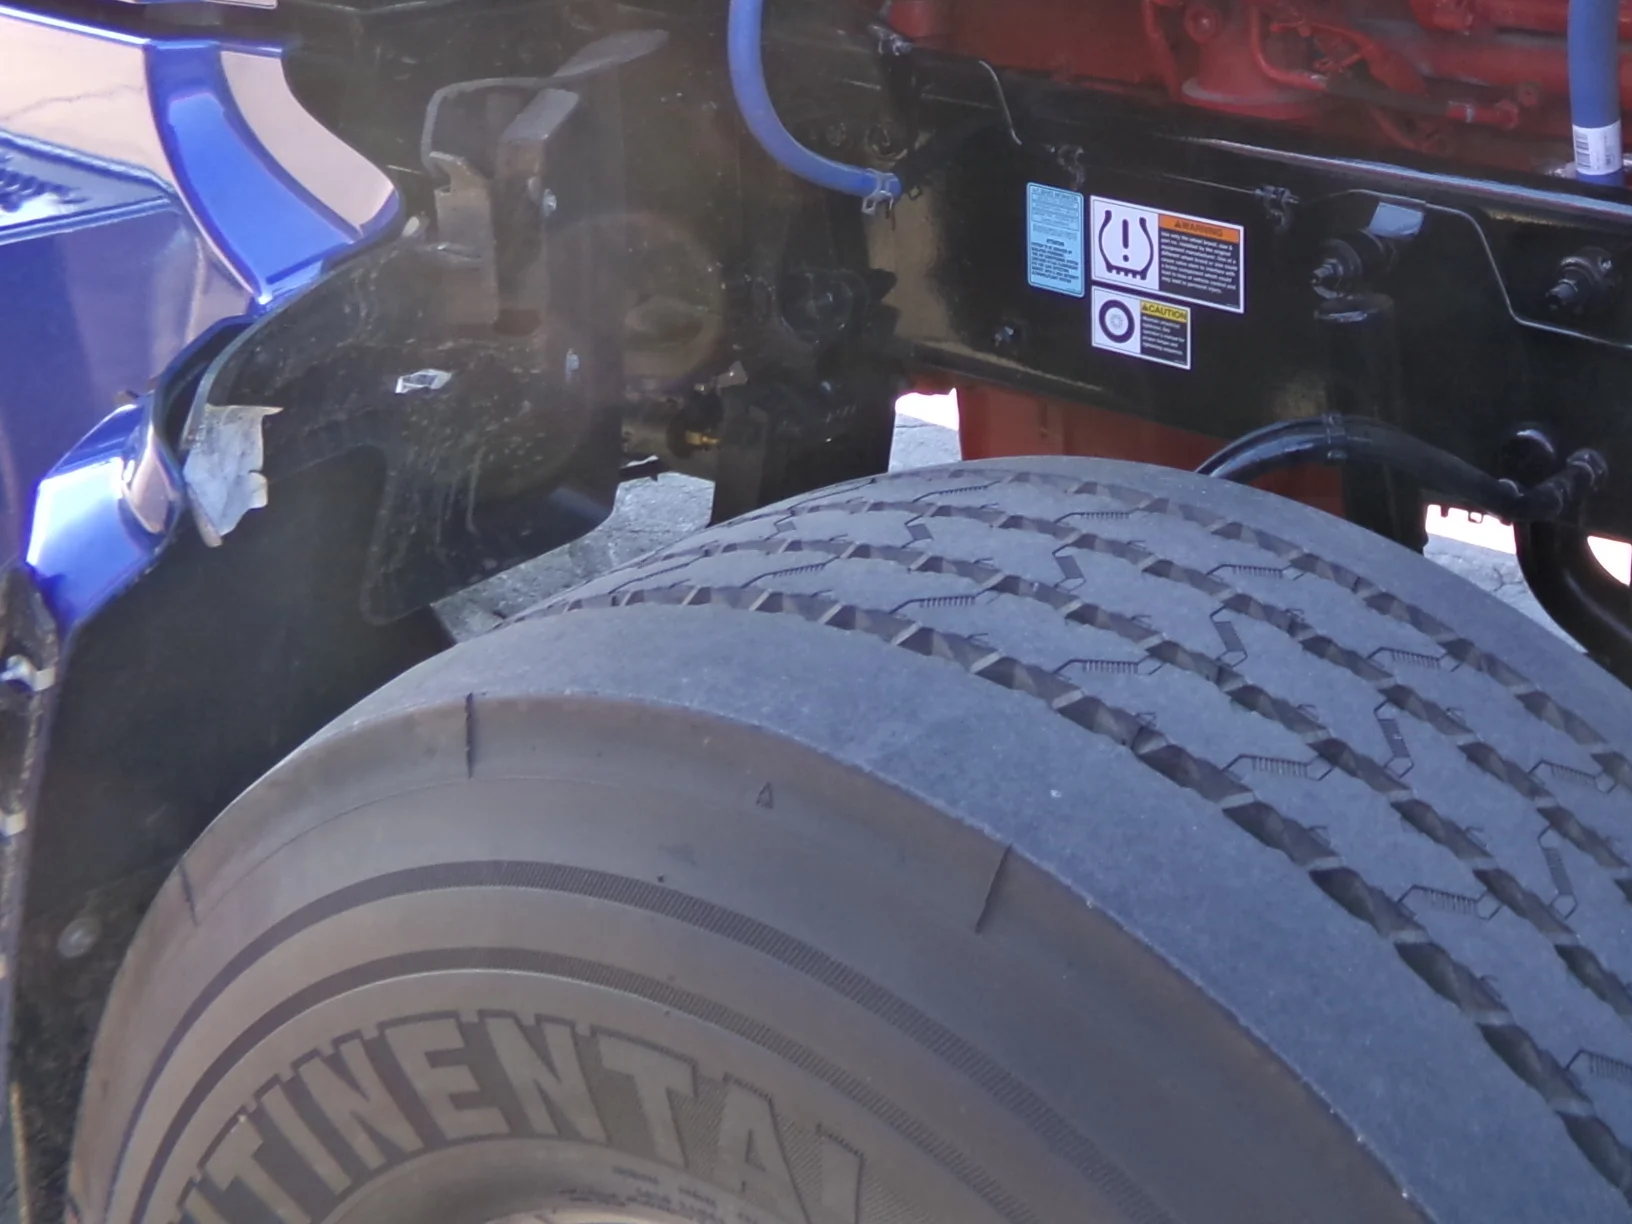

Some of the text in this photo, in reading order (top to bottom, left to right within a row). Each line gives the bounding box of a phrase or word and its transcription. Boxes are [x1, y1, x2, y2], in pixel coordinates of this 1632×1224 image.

[1182, 222, 1223, 237] WARNING
[1148, 305, 1187, 320] CAUTION
[172, 1007, 868, 1224] TINENTA
